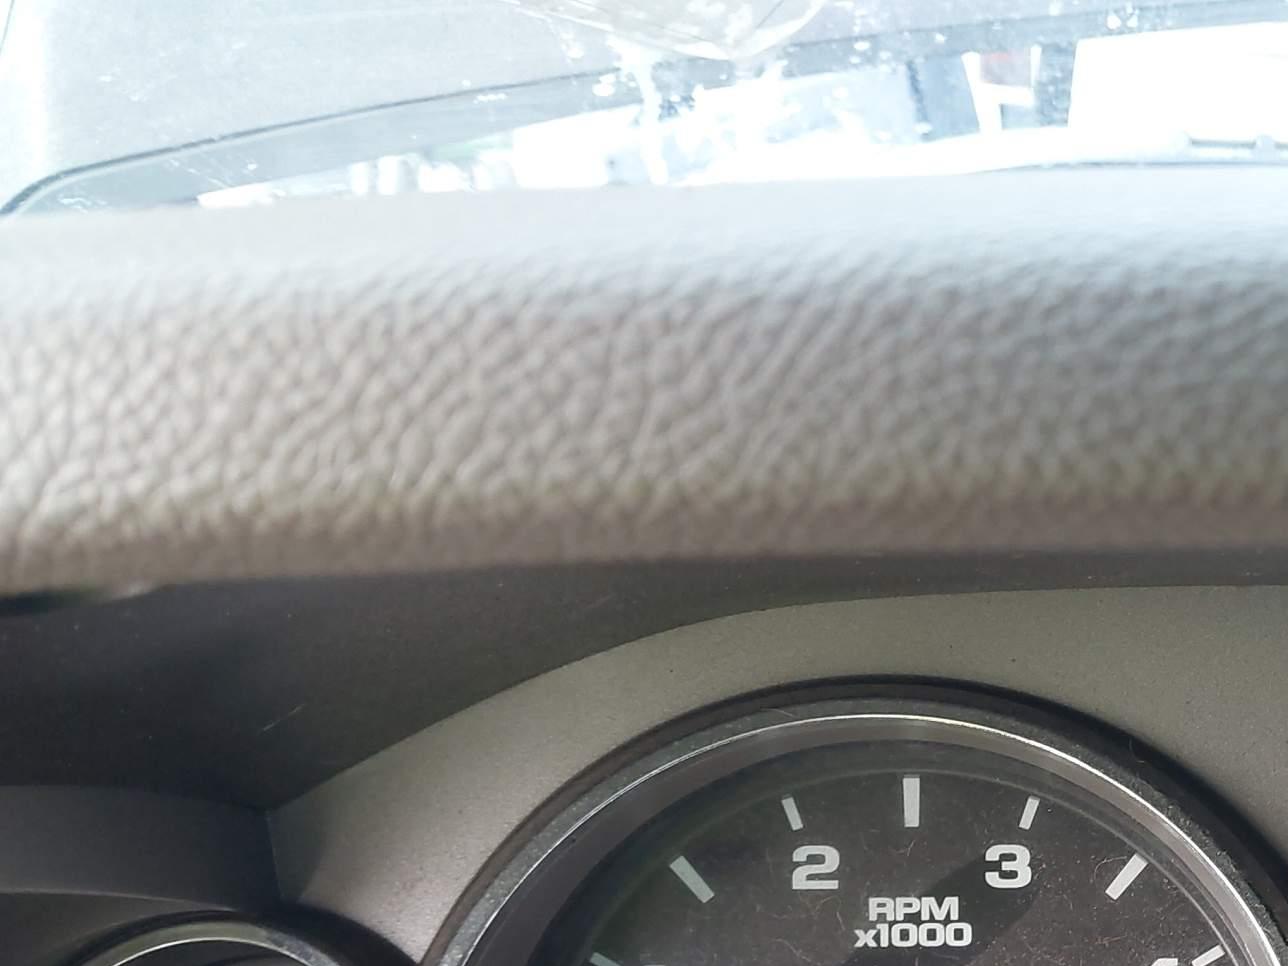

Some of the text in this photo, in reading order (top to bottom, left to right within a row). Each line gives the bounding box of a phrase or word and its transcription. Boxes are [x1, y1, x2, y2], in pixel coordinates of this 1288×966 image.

[790, 844, 841, 890] 2
[984, 844, 1033, 890] 3
[867, 897, 960, 922] RPM
[853, 922, 973, 949] x1000
